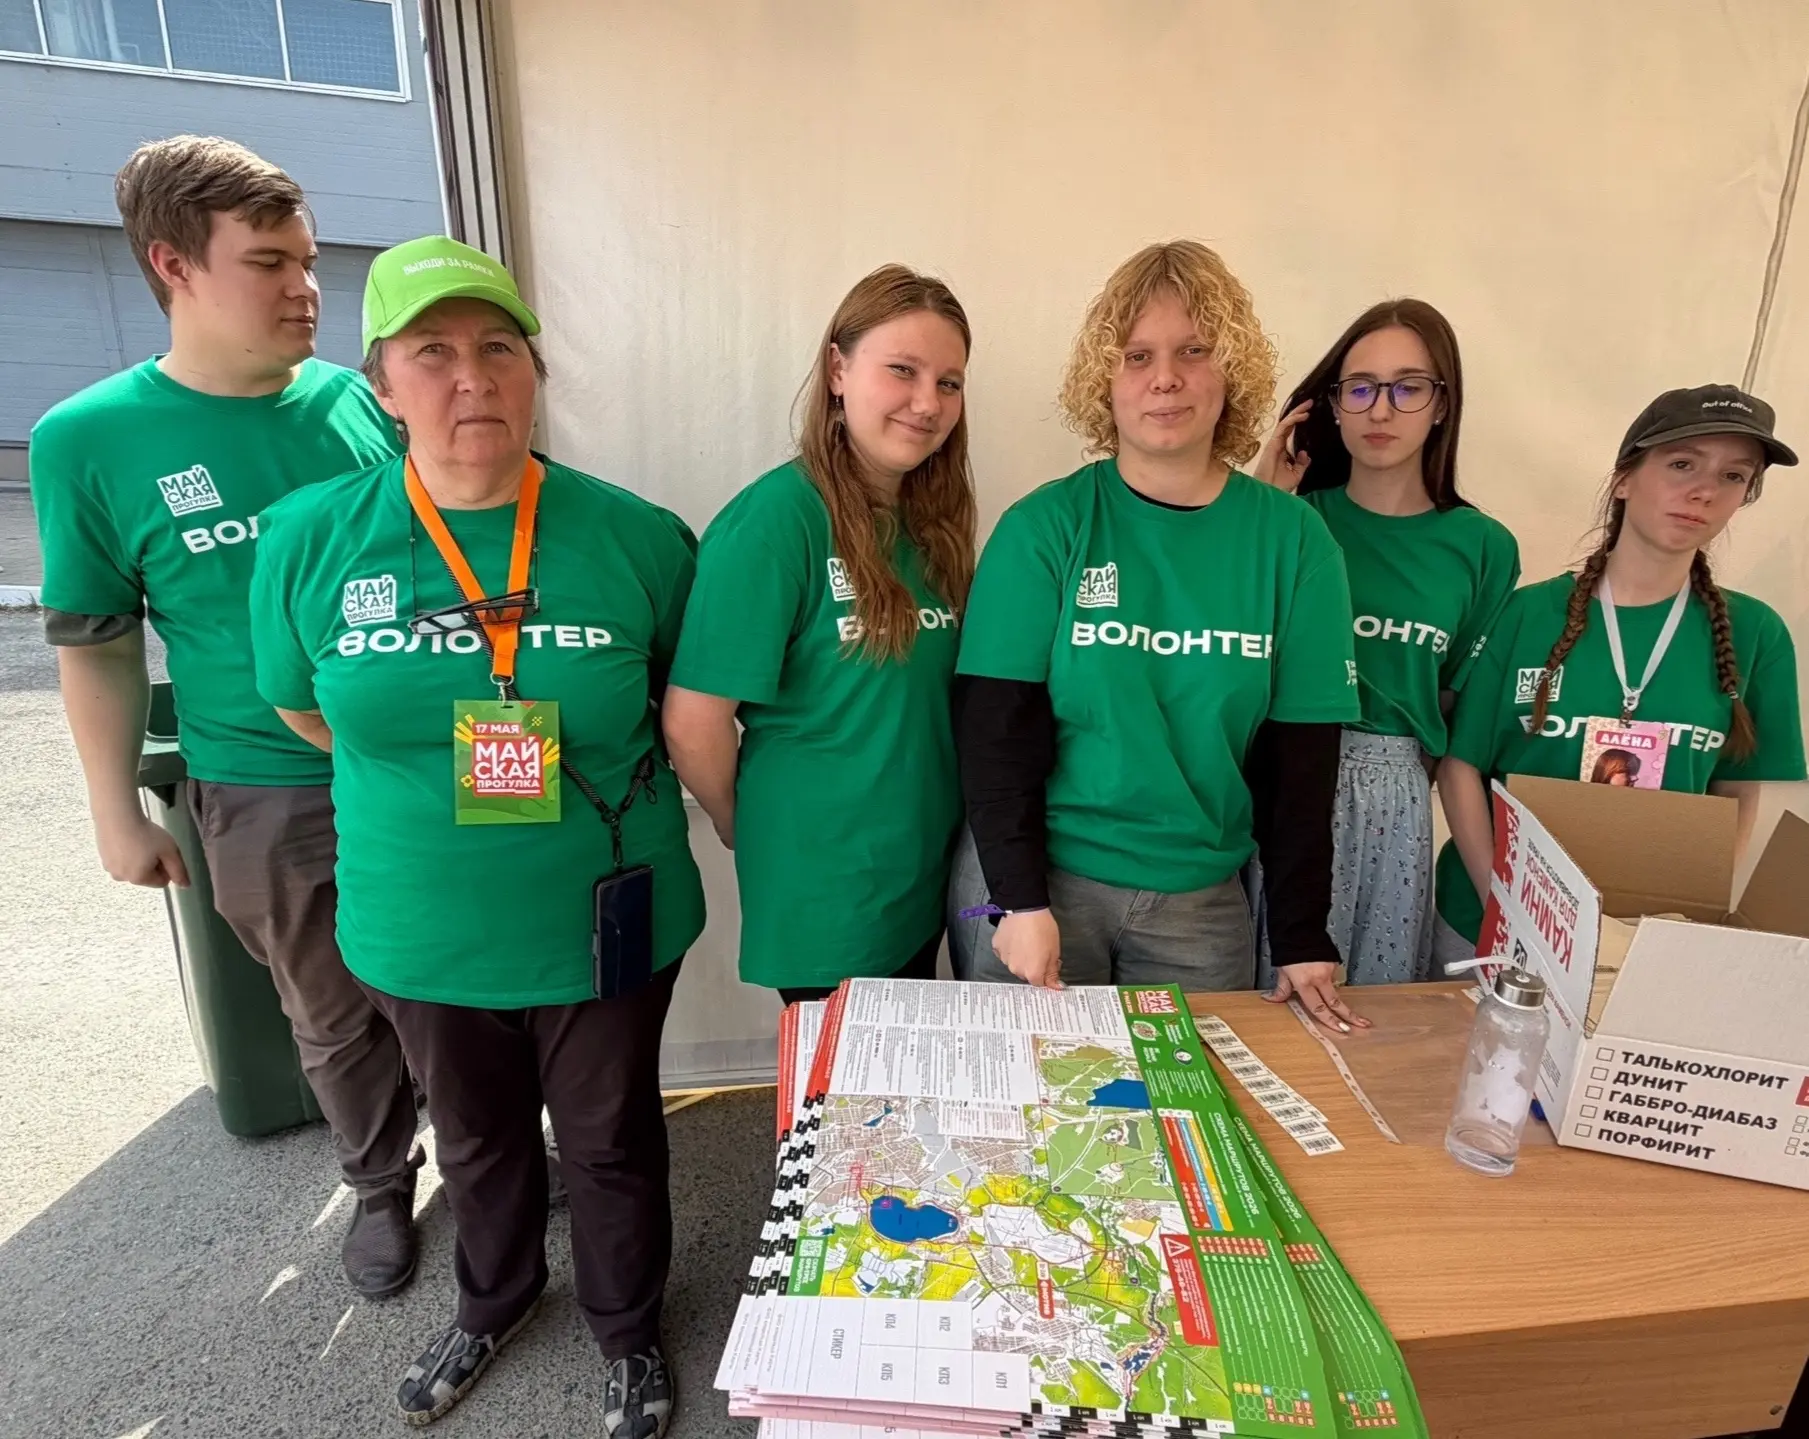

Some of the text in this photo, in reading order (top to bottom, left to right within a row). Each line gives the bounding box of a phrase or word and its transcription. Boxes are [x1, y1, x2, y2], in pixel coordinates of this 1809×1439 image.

[402, 257, 445, 276] ВЫХОДИ
[447, 257, 460, 267] ЗА
[160, 467, 212, 494] МАЙ
[166, 484, 215, 504] СКАЯ
[172, 495, 218, 511] ПРОГУЛКА
[1080, 564, 1117, 585] МАЙ
[345, 577, 394, 599] МАЙ
[1078, 581, 1117, 596] СКАЯ
[344, 595, 394, 614] СКАЯ
[346, 607, 394, 621] ПРОГУЛКА
[337, 625, 613, 657] ВОЛОТЕР
[475, 724, 520, 734] 17 МАЯ
[475, 736, 540, 761] МАЙ
[1599, 732, 1653, 749] АЛЁНА
[474, 761, 540, 779] СКАЯ
[476, 780, 540, 789] ПРОГУЛКА
[1519, 871, 1575, 974] КАМНИ
[1558, 895, 1578, 932] ДЛЯ
[1621, 1050, 1790, 1090] ТАЛЬКОХЛОРИТ
[1612, 1070, 1688, 1094] ДУНИТ
[1608, 1090, 1778, 1131] ГАББРО-ДИАБАЗ
[1603, 1109, 1704, 1137] КВАРЦИТ
[1597, 1128, 1716, 1160] ПОРФИРИТ
[1213, 1112, 1260, 1215] СХЕМА МАРШРУТОВ 2026
[1233, 1116, 1302, 1219] СХЕМА МАРШРУТОВ 2026
[884, 1313, 897, 1329] КП4
[939, 1316, 951, 1331] КП2
[830, 1328, 846, 1360] СТИКЕР
[880, 1362, 894, 1381] КП5
[938, 1366, 950, 1385] КП3
[995, 1371, 1008, 1389] КП1
